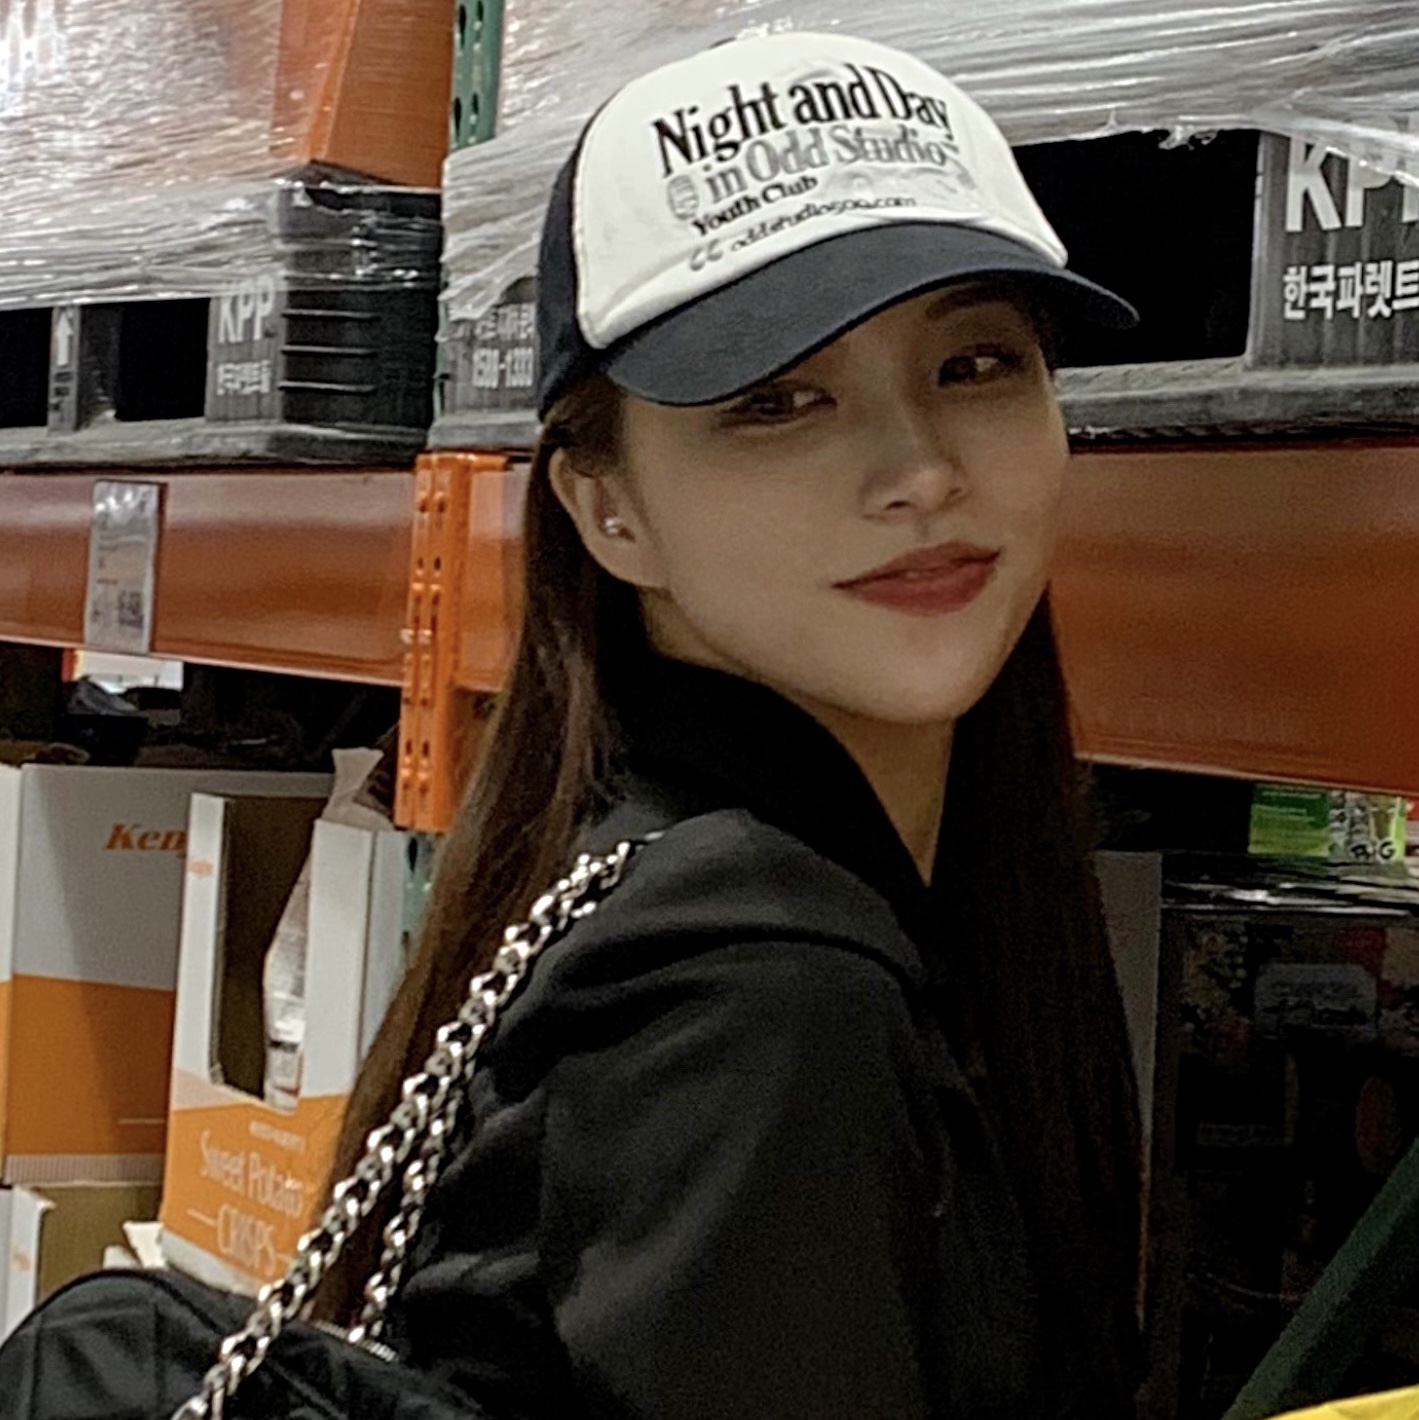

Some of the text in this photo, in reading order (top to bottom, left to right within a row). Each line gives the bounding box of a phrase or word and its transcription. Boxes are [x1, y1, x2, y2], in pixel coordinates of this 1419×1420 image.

[651, 63, 956, 179] Night and Day
[702, 124, 948, 204] in Odd Studio
[691, 175, 820, 237] Youth Club
[105, 822, 188, 859] Ken
